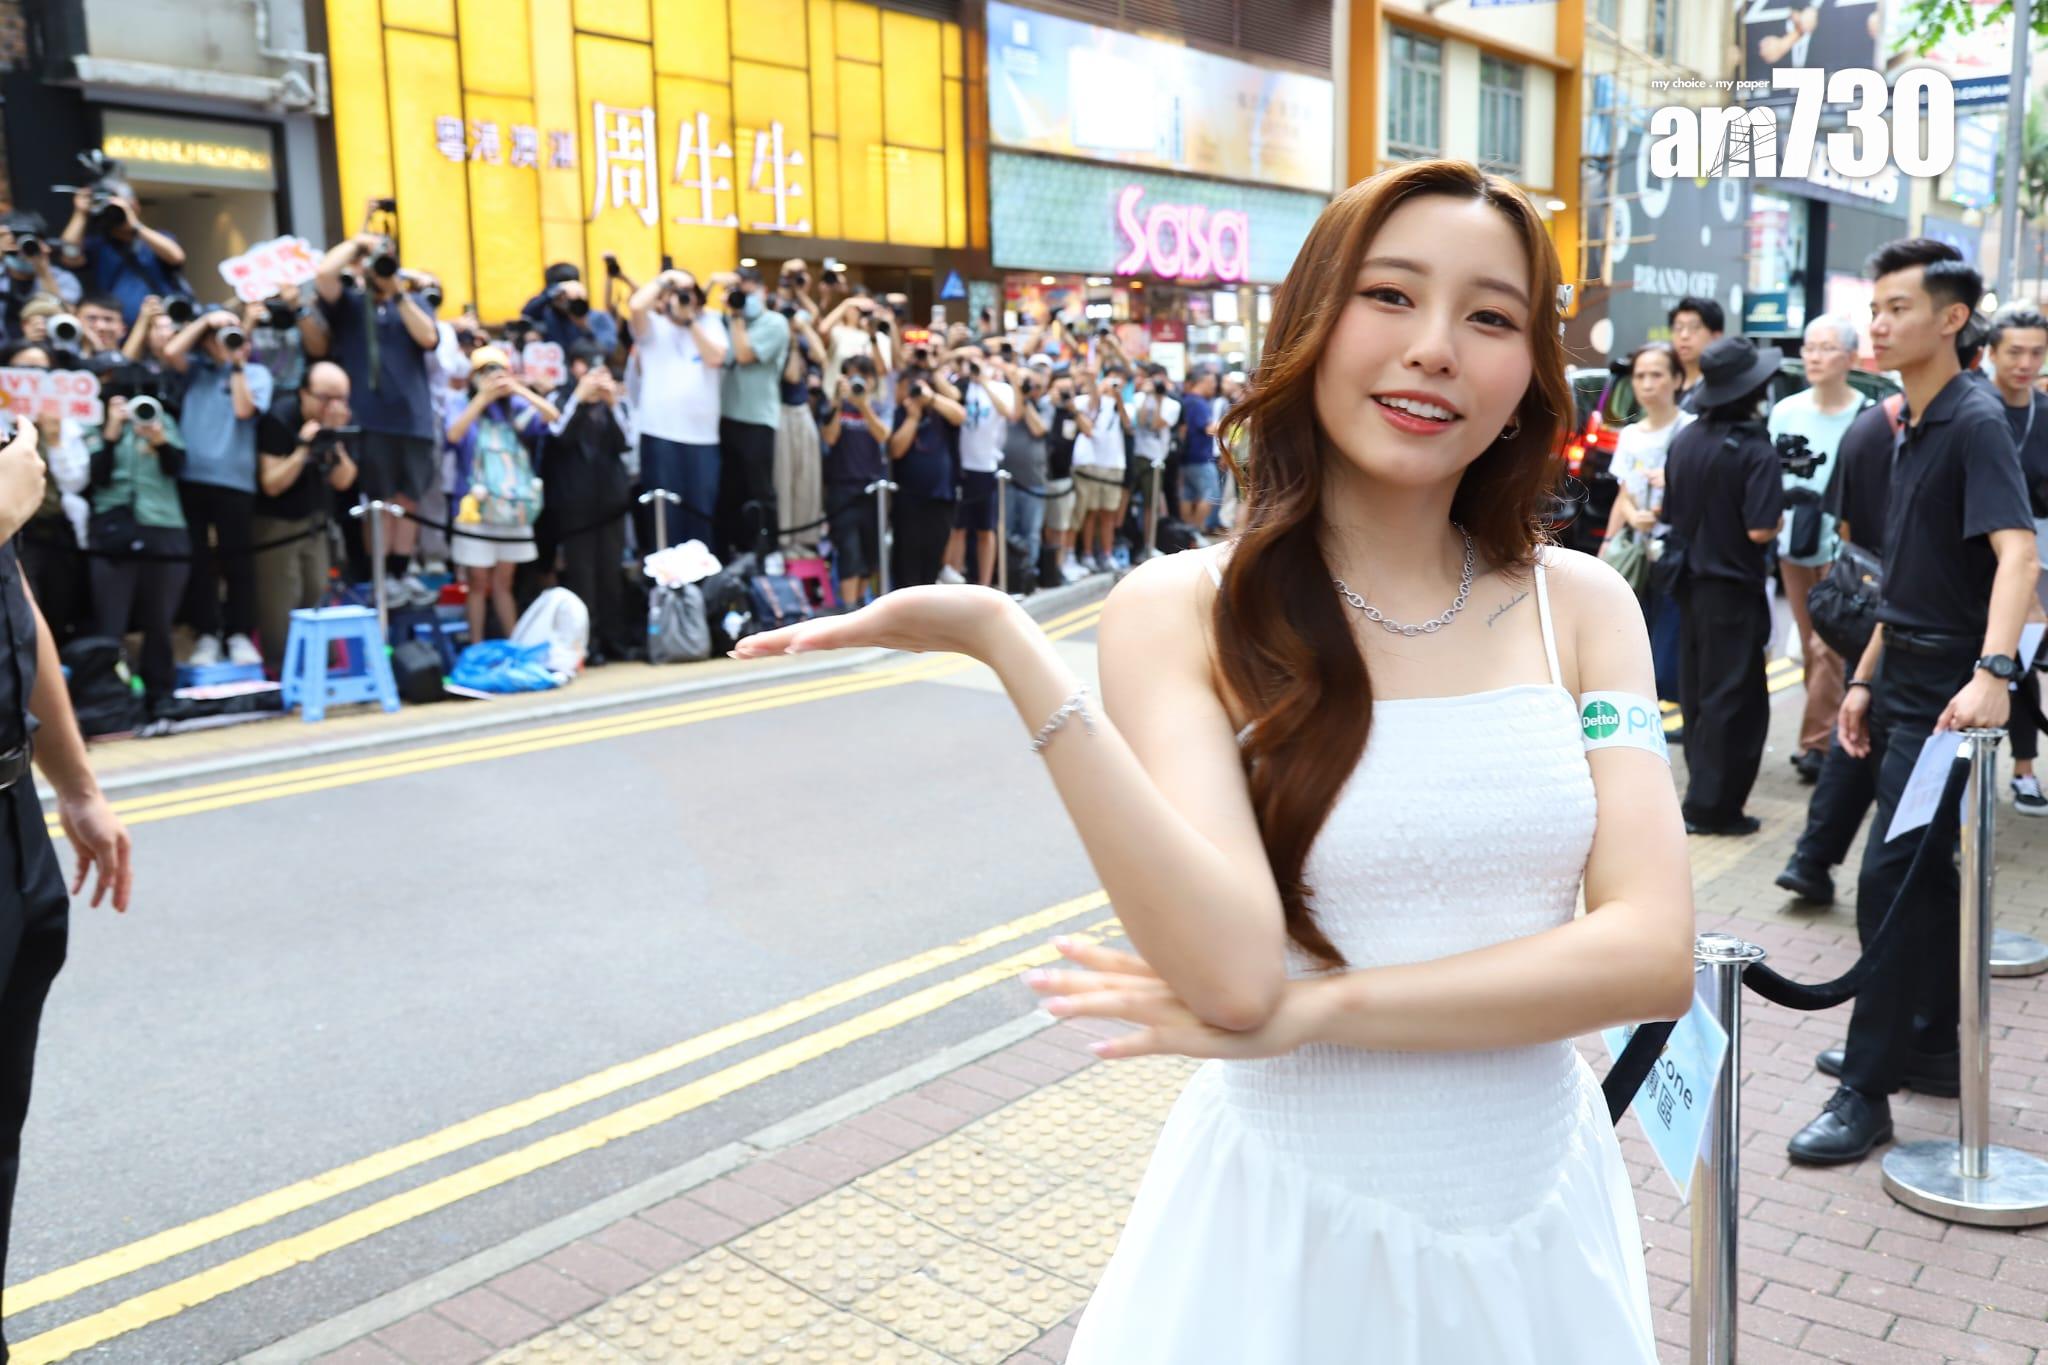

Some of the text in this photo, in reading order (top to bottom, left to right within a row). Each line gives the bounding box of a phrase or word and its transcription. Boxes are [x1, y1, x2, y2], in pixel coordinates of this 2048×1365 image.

[592, 101, 811, 232] 周生生
[1633, 264, 1719, 299] BRAND OFF
[1582, 713, 1619, 729] Dettol
[1658, 1057, 1693, 1111] one
